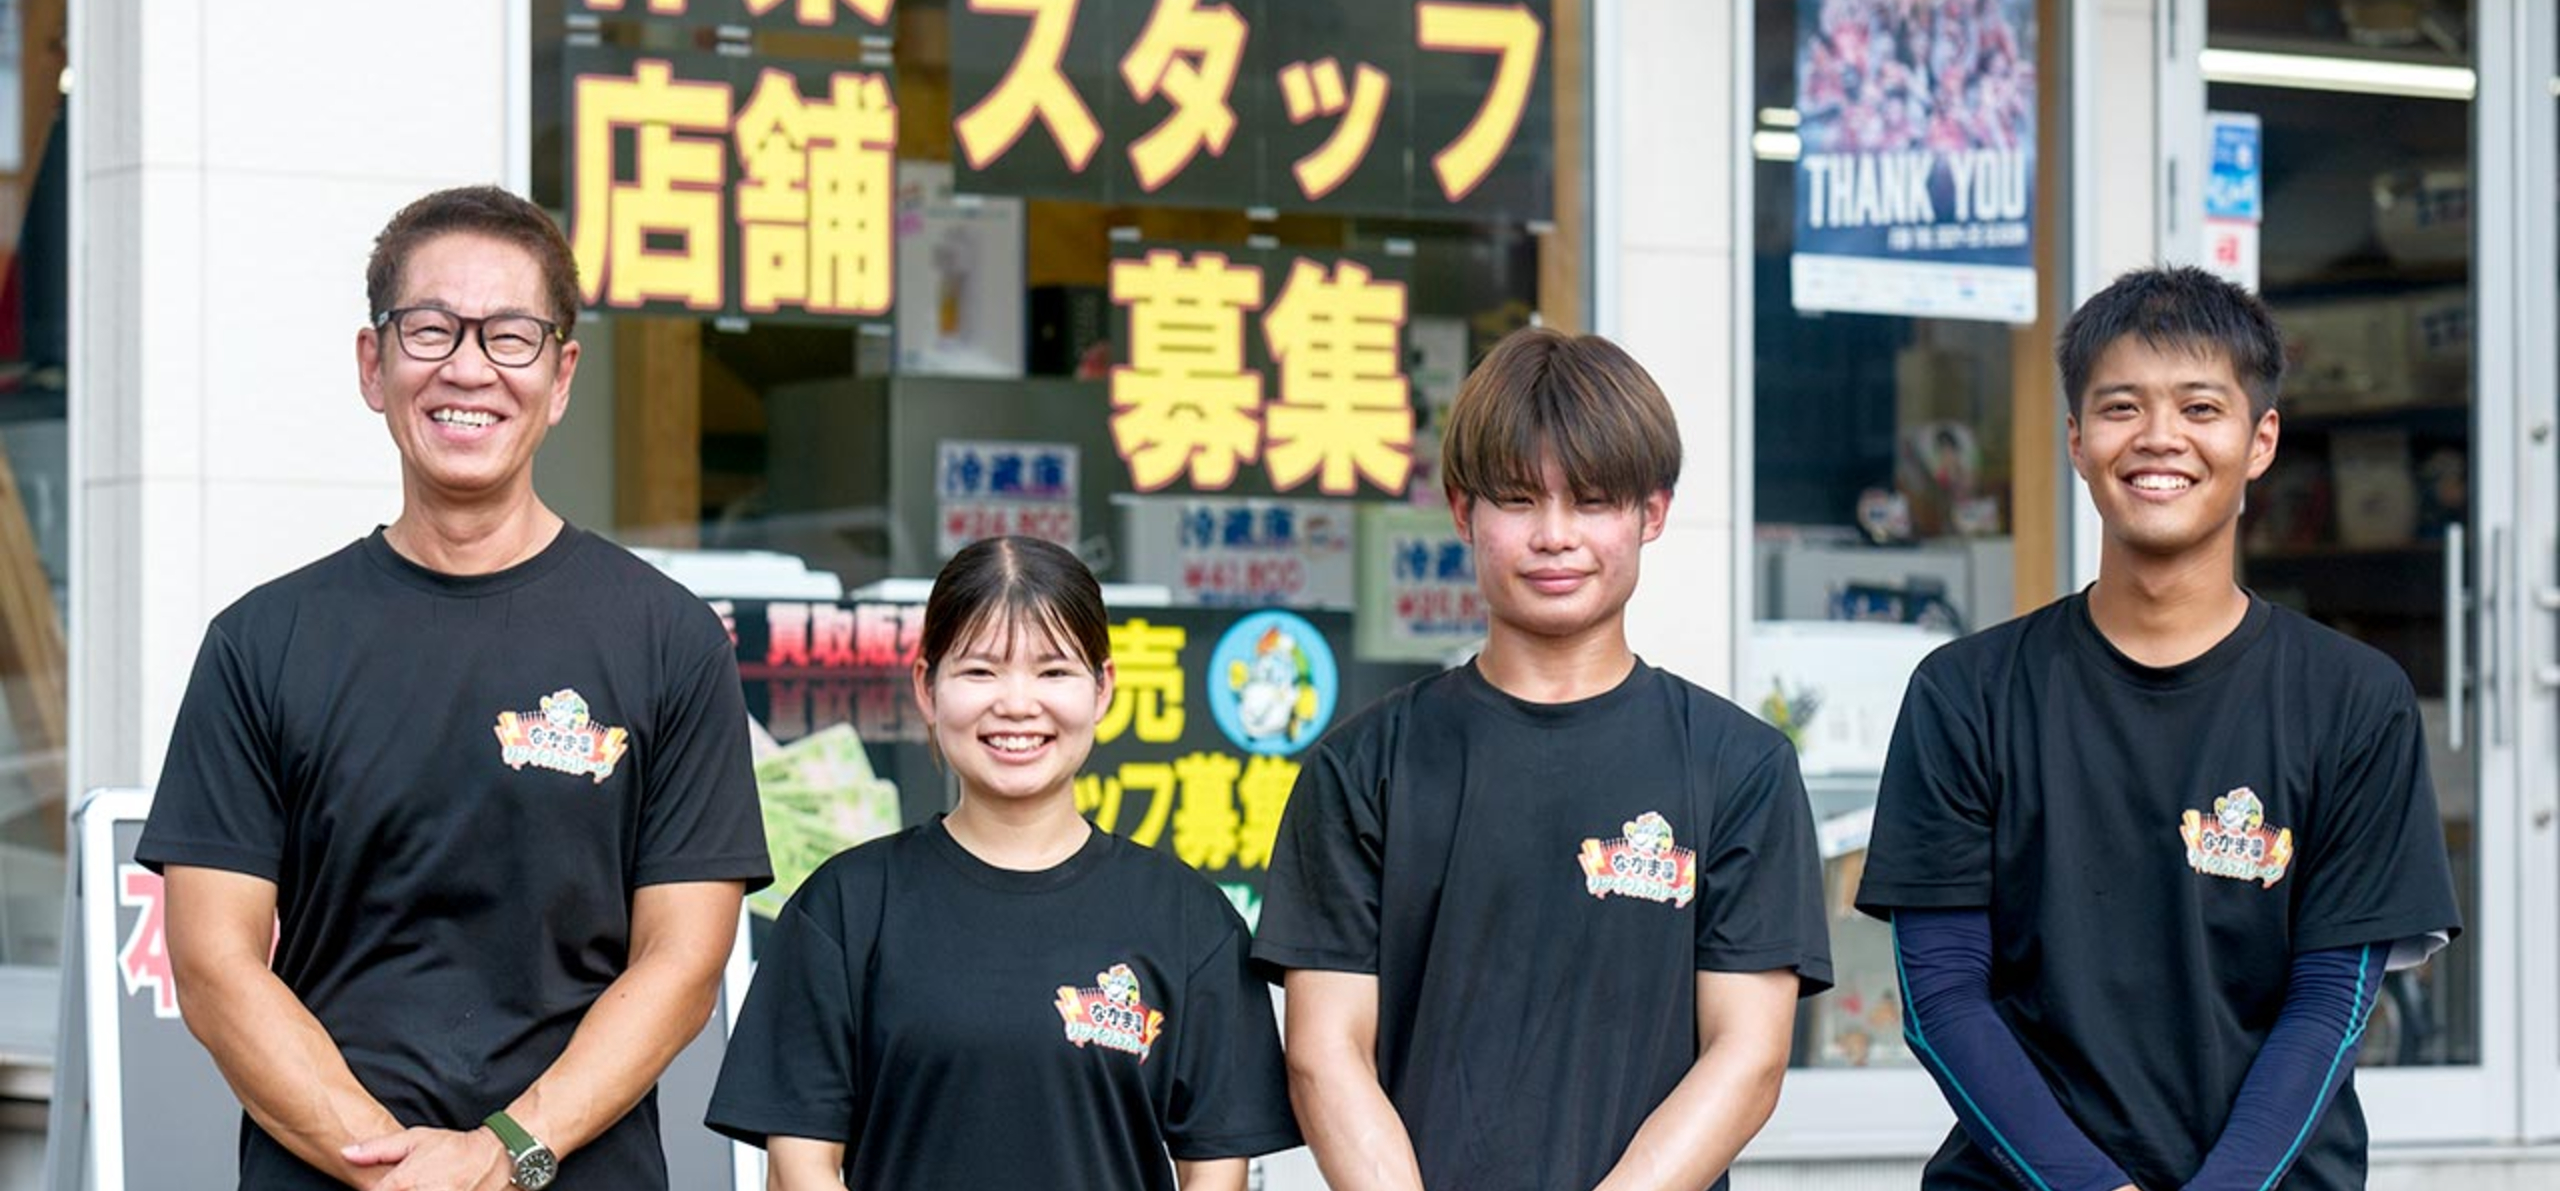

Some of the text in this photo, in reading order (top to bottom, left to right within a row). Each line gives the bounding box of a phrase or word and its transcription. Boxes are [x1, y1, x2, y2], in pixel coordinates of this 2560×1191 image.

[570, 59, 898, 313] 店舗
[954, 0, 1544, 201] スタッフ
[1802, 147, 2028, 229] THANK YOU
[1110, 250, 1415, 496] 募集
[1394, 540, 1474, 580] 冷蔵
